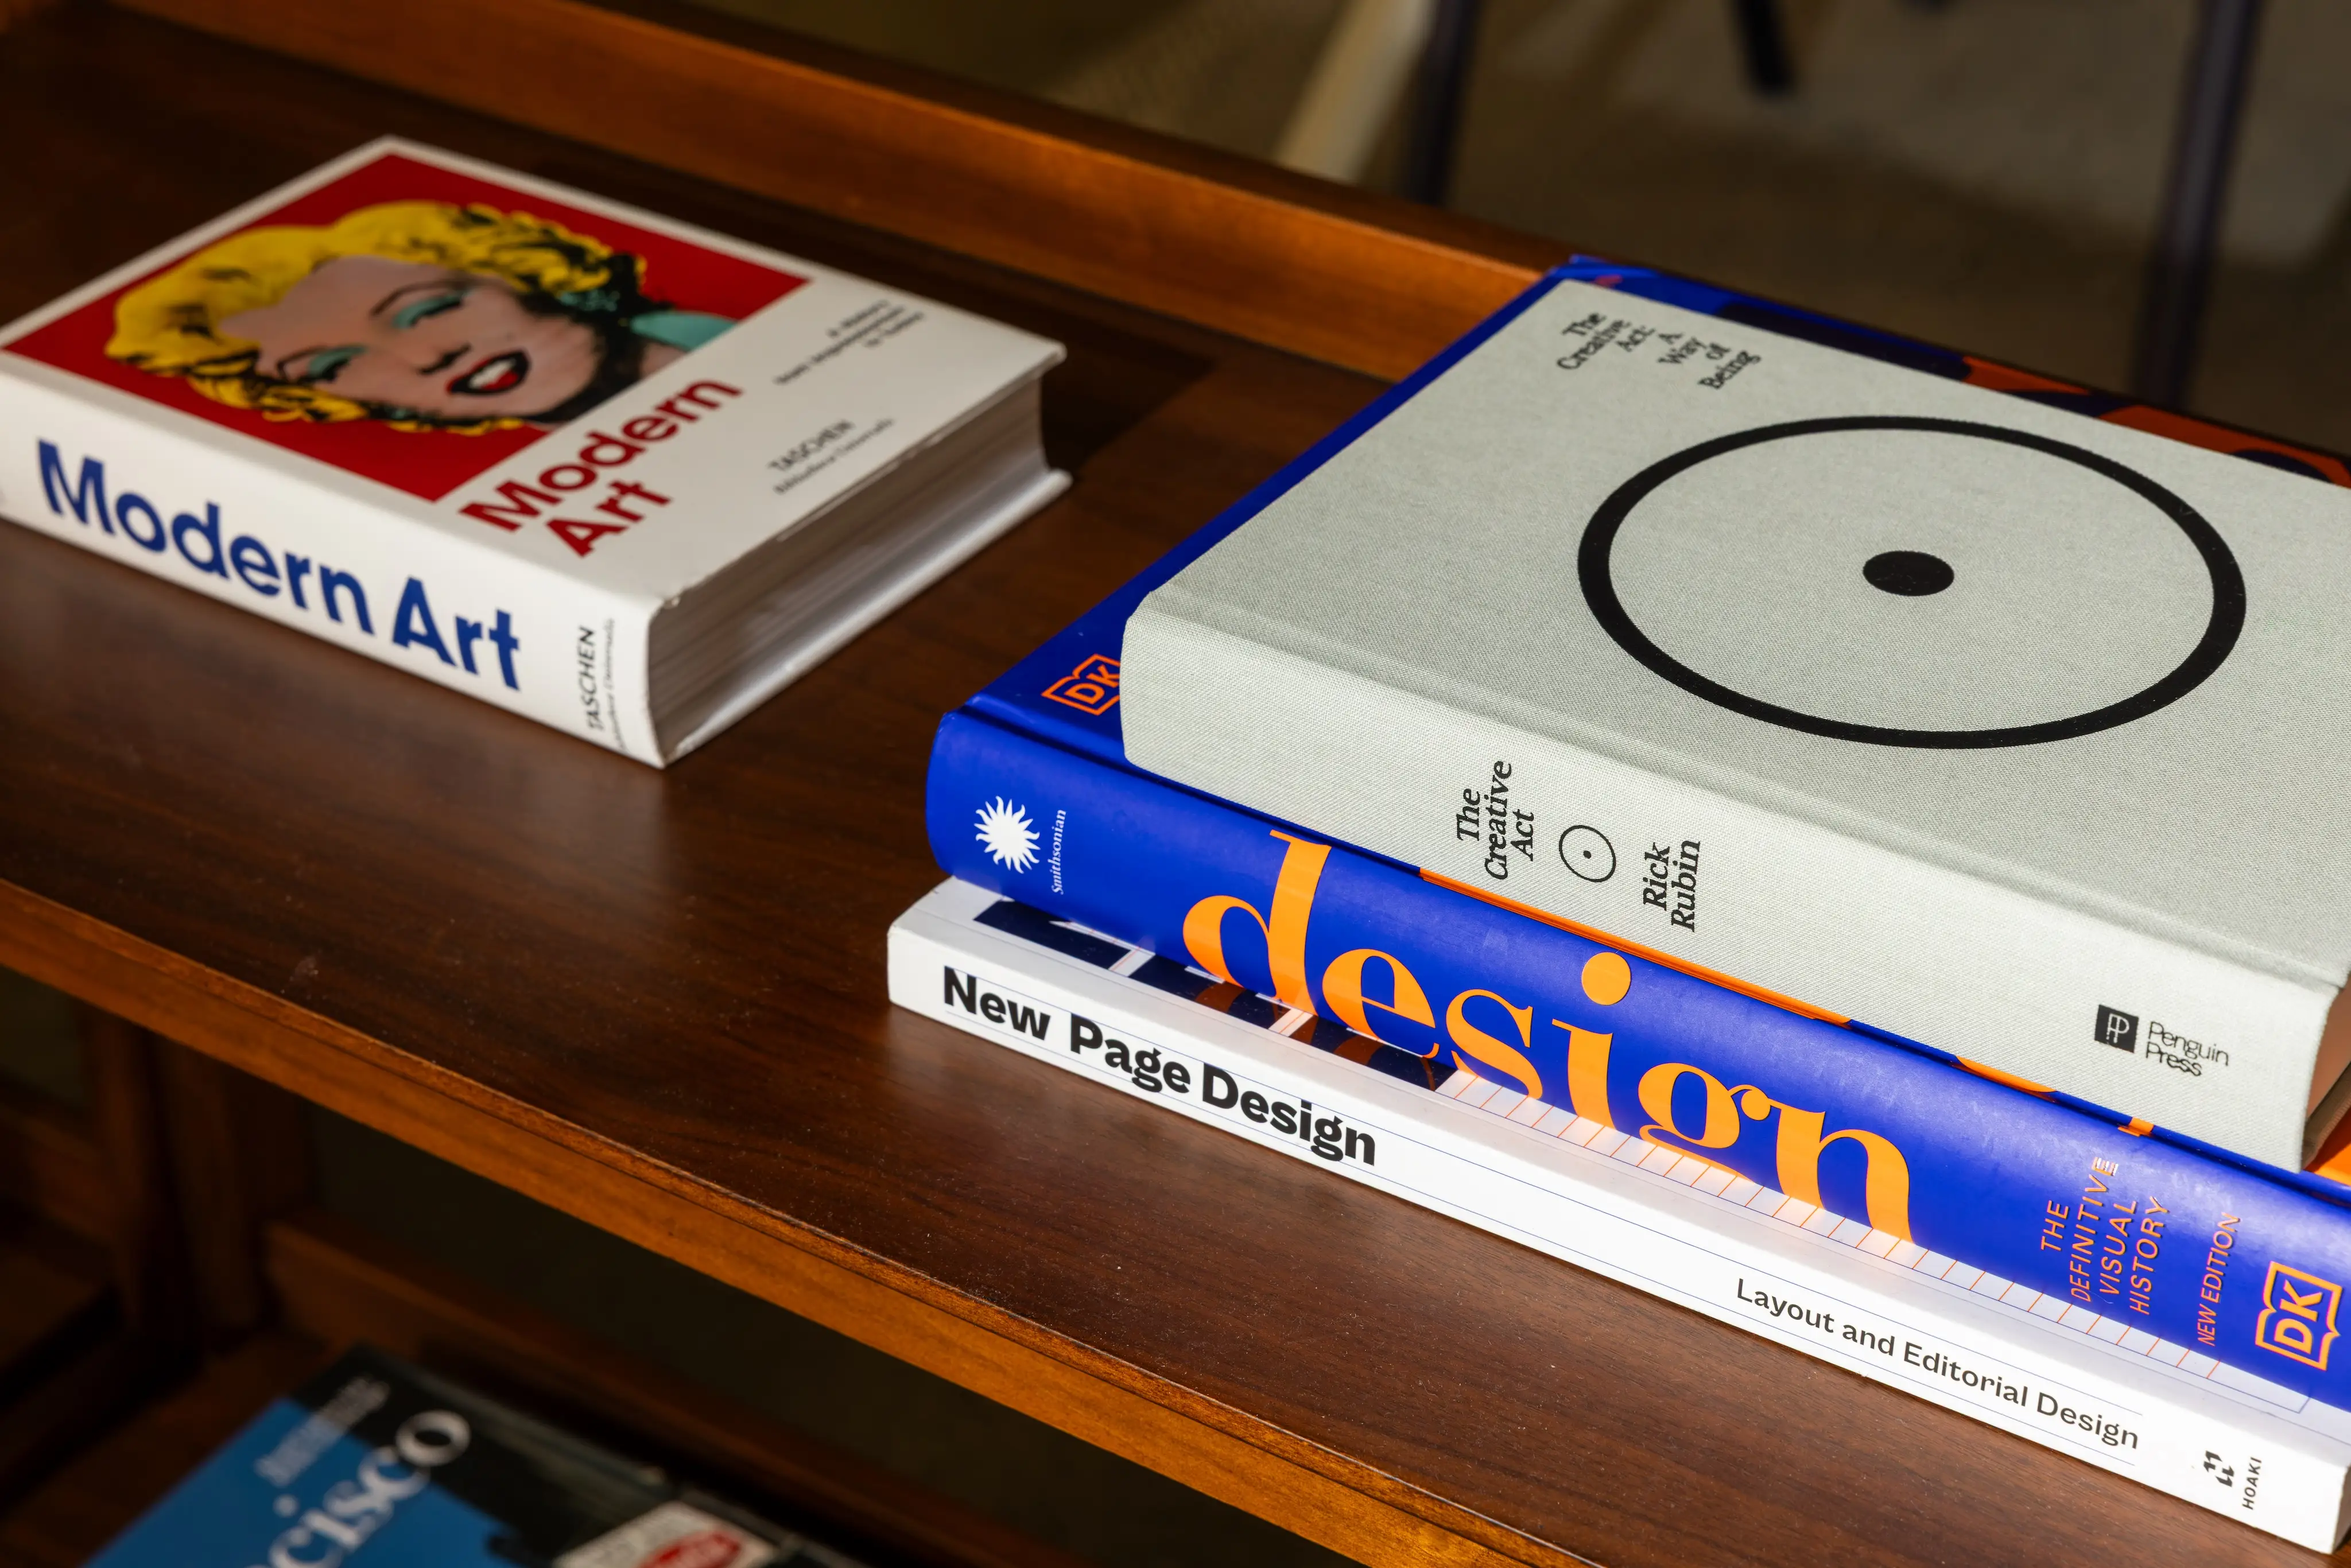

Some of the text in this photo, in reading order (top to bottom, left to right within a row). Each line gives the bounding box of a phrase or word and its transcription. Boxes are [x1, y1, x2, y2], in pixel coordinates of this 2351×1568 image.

[1556, 319, 1632, 370] Creative
[1561, 312, 1607, 337] The
[1656, 336, 1706, 365] Way
[1657, 331, 1685, 344] A
[1705, 342, 1732, 360] of
[1697, 350, 1762, 390] Being
[458, 379, 743, 533] Modern
[546, 480, 673, 557] Art
[38, 437, 374, 636] Modern
[392, 577, 520, 690] Art
[577, 625, 605, 731] TASCHEN
[1064, 665, 1121, 705] DK
[1050, 809, 1066, 895] Smithsonian
[1456, 789, 1480, 841] The
[1485, 760, 1512, 880] Creative
[1511, 809, 1534, 861] Act
[1643, 843, 1670, 911] Rick
[1671, 840, 1700, 933] Rubin
[944, 965, 1375, 1166] New Page Design
[1182, 829, 1915, 1244] design
[2146, 1041, 2202, 1077] Press
[2148, 1021, 2228, 1066] Penguin
[2041, 1200, 2069, 1251] THE
[2070, 1156, 2119, 1302] DEFINITIVE
[2100, 1200, 2137, 1295] VISUAL
[2129, 1196, 2169, 1315] HISTORY
[2198, 1212, 2240, 1346] NEW EDITION
[2274, 1279, 2322, 1354] DK
[1737, 1278, 2139, 1450] Layout and Editorial Design
[244, 1410, 470, 1568] cisco
[2242, 1457, 2262, 1510] HOAKI
